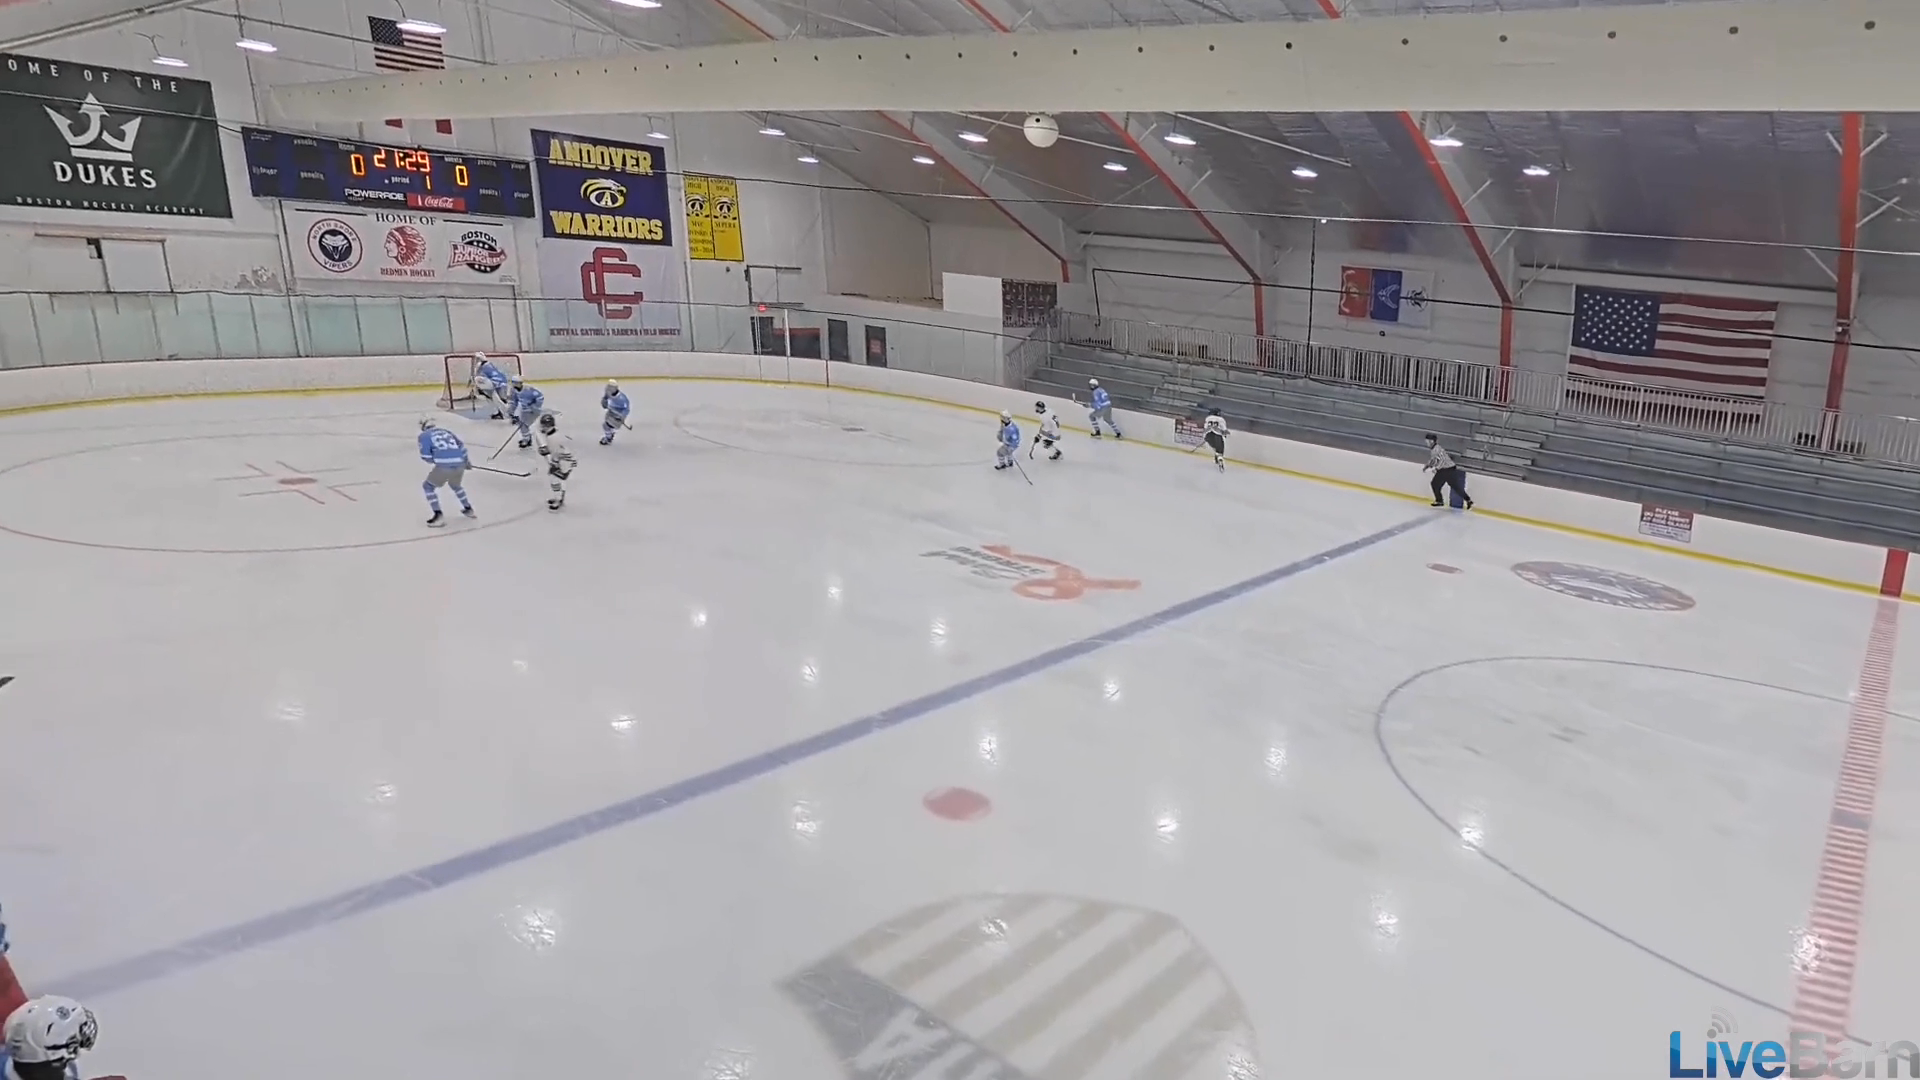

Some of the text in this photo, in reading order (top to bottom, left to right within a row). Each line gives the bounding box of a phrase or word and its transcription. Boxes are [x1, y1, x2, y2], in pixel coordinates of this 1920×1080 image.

[8, 58, 178, 93] OME OF THE
[350, 153, 366, 176] 0
[373, 147, 431, 172] 21:29
[548, 138, 654, 176] ANDOVER
[53, 160, 157, 189] DUKES
[426, 174, 431, 190] 1
[455, 165, 468, 186] 0
[344, 188, 405, 201] POWERADE
[145, 204, 205, 215] ACADEMY
[375, 212, 437, 226] HOME OF
[549, 210, 664, 240] WARRIORS
[461, 230, 497, 246] BOSTON
[455, 244, 489, 257] JUNIOR
[323, 258, 353, 270] VIPERS
[410, 269, 436, 278] HOCKEY
